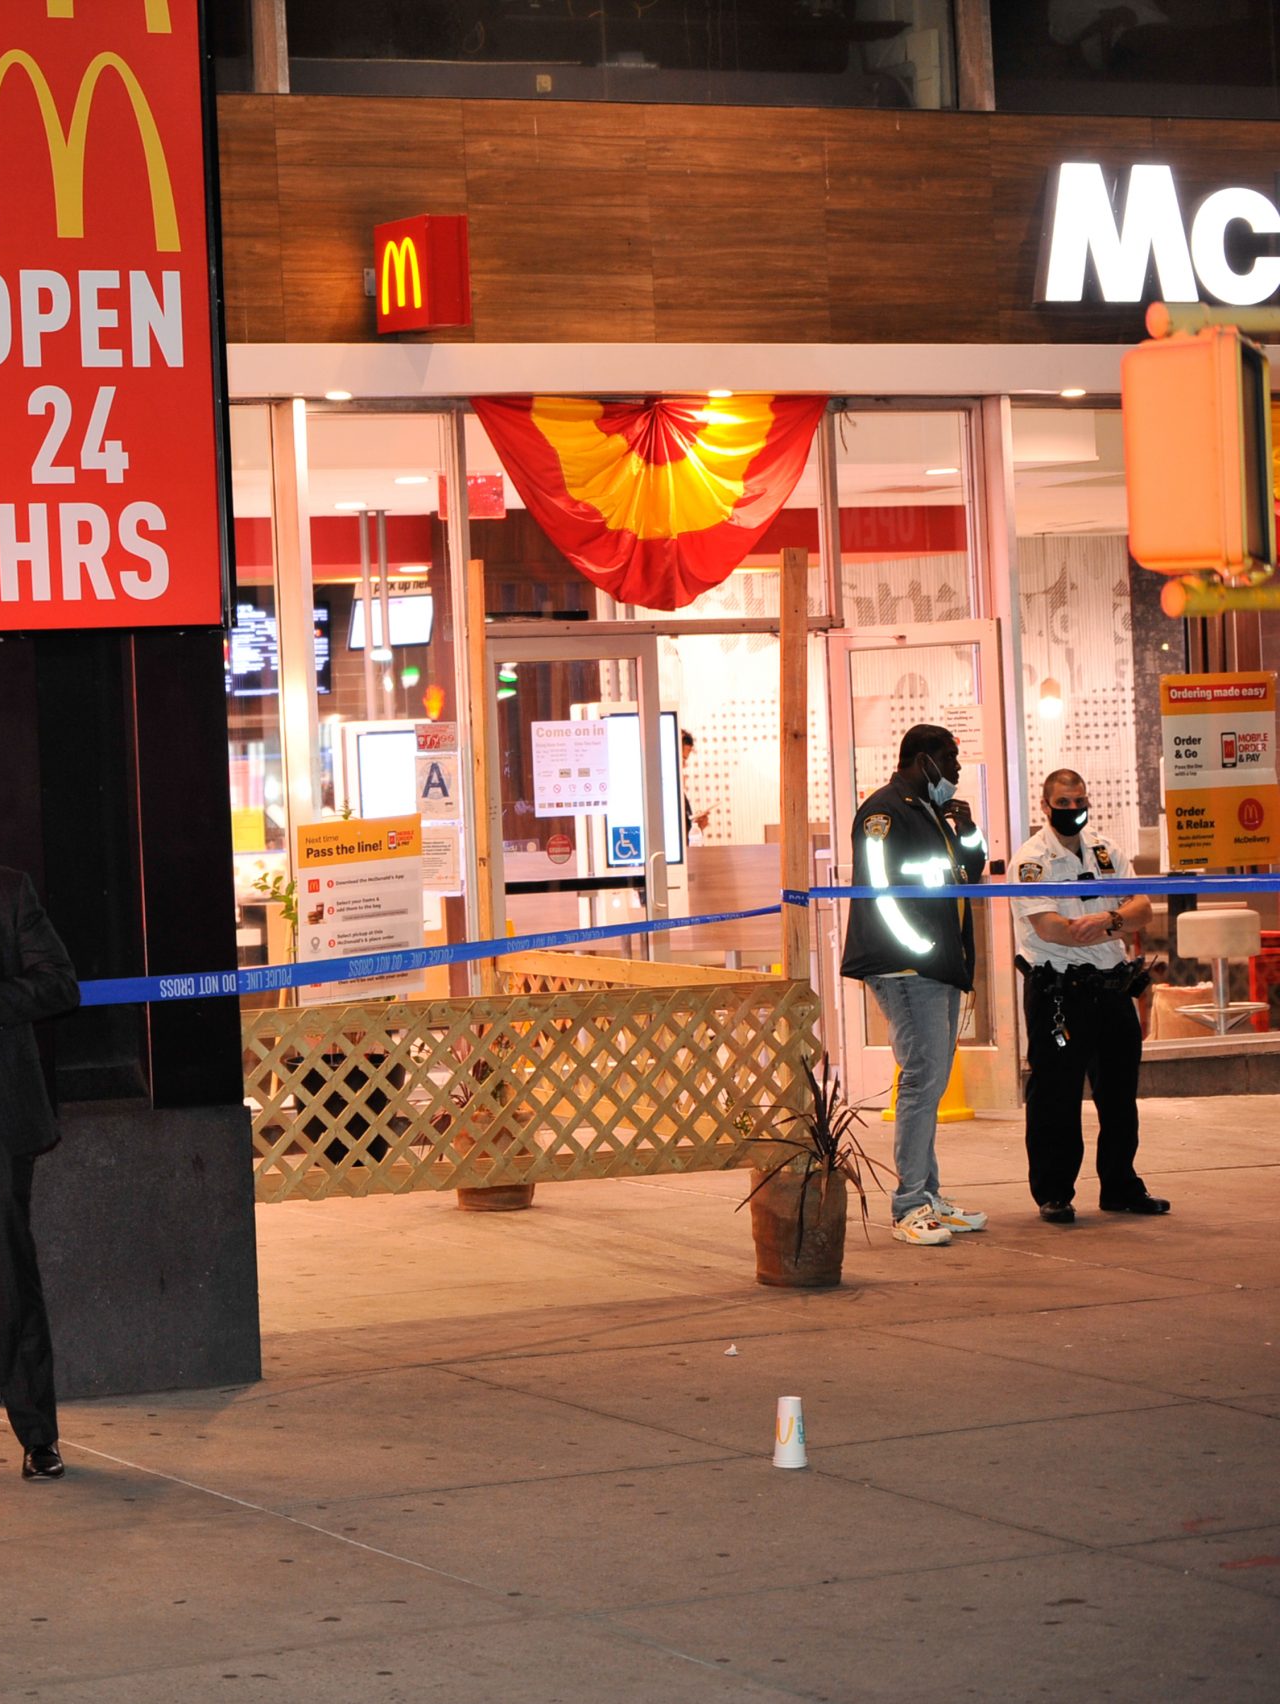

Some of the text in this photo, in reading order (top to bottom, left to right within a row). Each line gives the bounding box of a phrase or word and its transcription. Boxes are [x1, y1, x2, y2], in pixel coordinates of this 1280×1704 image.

[27, 385, 129, 484] 24
[1170, 686, 1265, 700] Ordering made easy
[536, 724, 604, 738] Come on in
[1174, 735, 1202, 746] Order
[1238, 733, 1268, 742] MOBILE
[1238, 743, 1267, 753] ORDER
[1175, 749, 1198, 759] & Go
[1245, 753, 1261, 762] PAY
[422, 762, 449, 798] A
[1175, 807, 1206, 817] Order
[1176, 819, 1215, 830] & Relax
[306, 835, 339, 845] Next time
[1233, 836, 1270, 844] McDelivery
[306, 840, 382, 859] Pass the line!
[160, 967, 292, 998] POLICE LINE DO NOT CROSS
